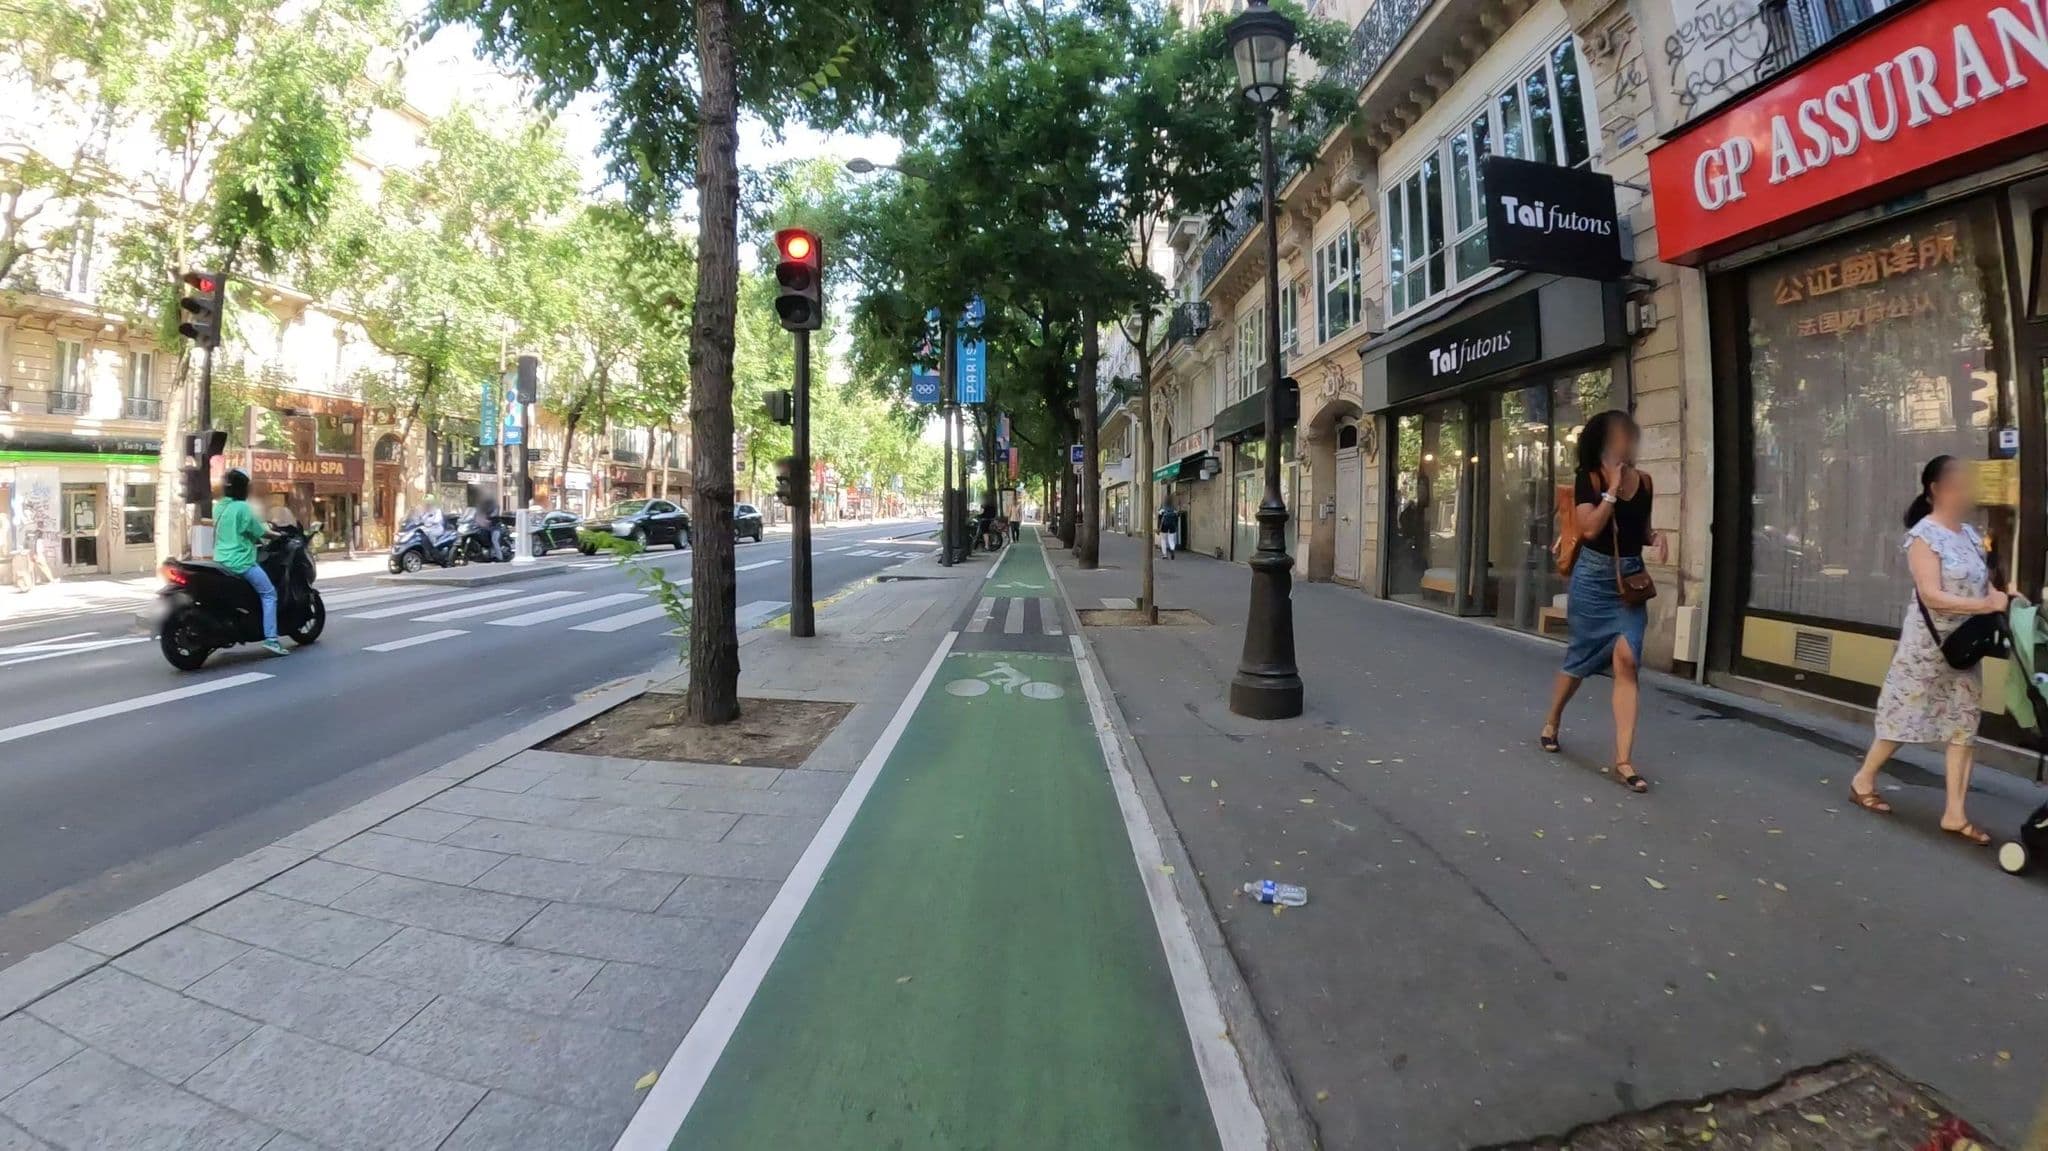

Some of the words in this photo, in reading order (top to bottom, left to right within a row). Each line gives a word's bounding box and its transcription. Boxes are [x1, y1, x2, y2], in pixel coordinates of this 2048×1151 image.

[1694, 136, 1754, 210] GP
[1501, 195, 1544, 228] Taï
[1544, 205, 1611, 235] futons
[966, 347, 977, 393] PARIS
[1429, 342, 1457, 376] Taï
[1456, 330, 1512, 374] futons
[287, 459, 317, 474] THAI
[320, 461, 345, 475] SPA
